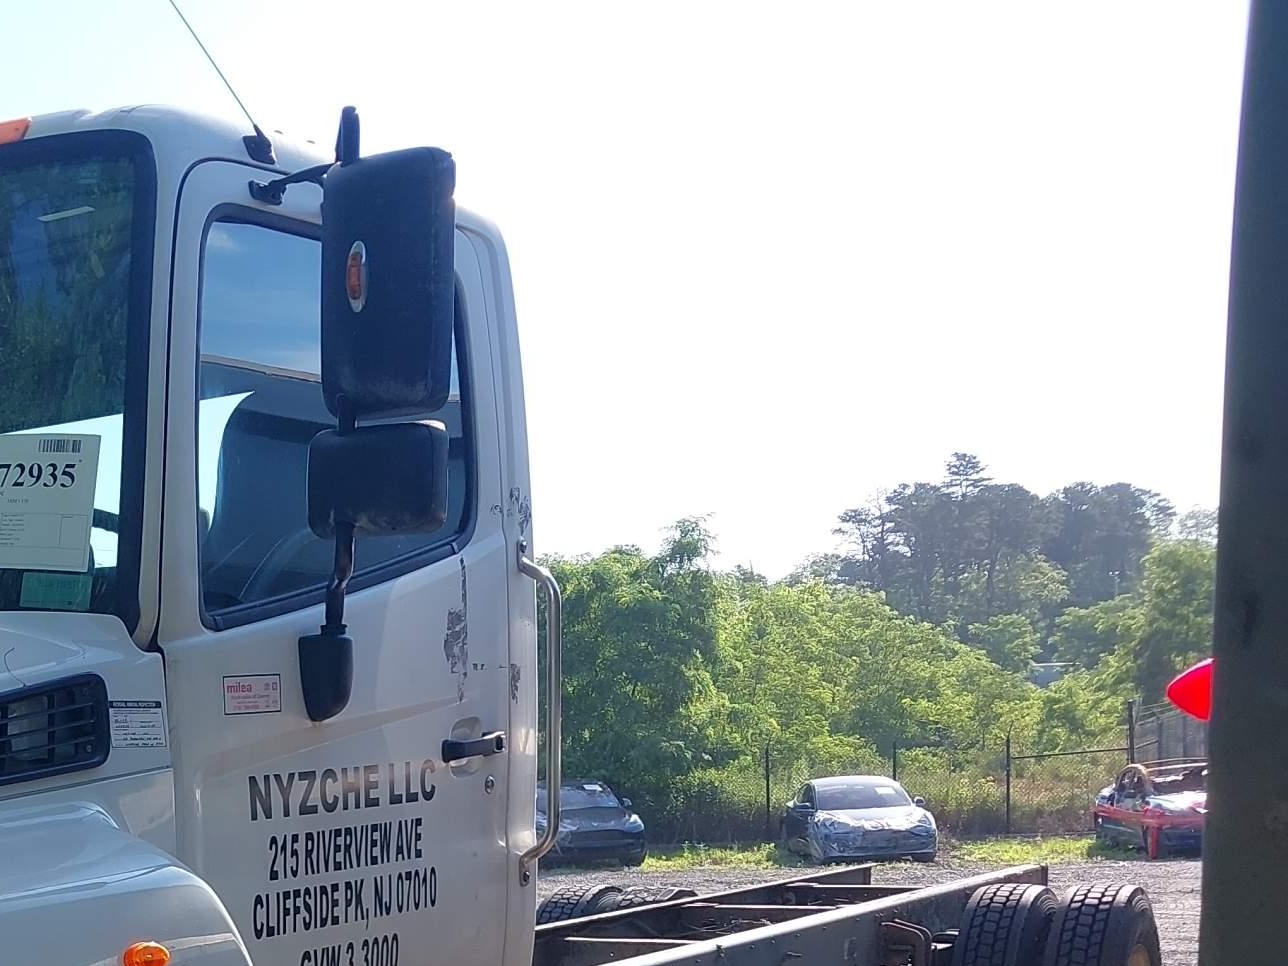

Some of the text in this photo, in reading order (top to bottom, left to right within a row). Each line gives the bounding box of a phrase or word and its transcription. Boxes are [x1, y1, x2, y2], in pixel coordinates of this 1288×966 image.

[226, 681, 252, 693] milea
[248, 759, 436, 821] NYZCHE LLC
[269, 817, 423, 881] 215 RIVERVIEW AVE
[252, 866, 437, 940] CLIFFSIDE PK, NJ 07010
